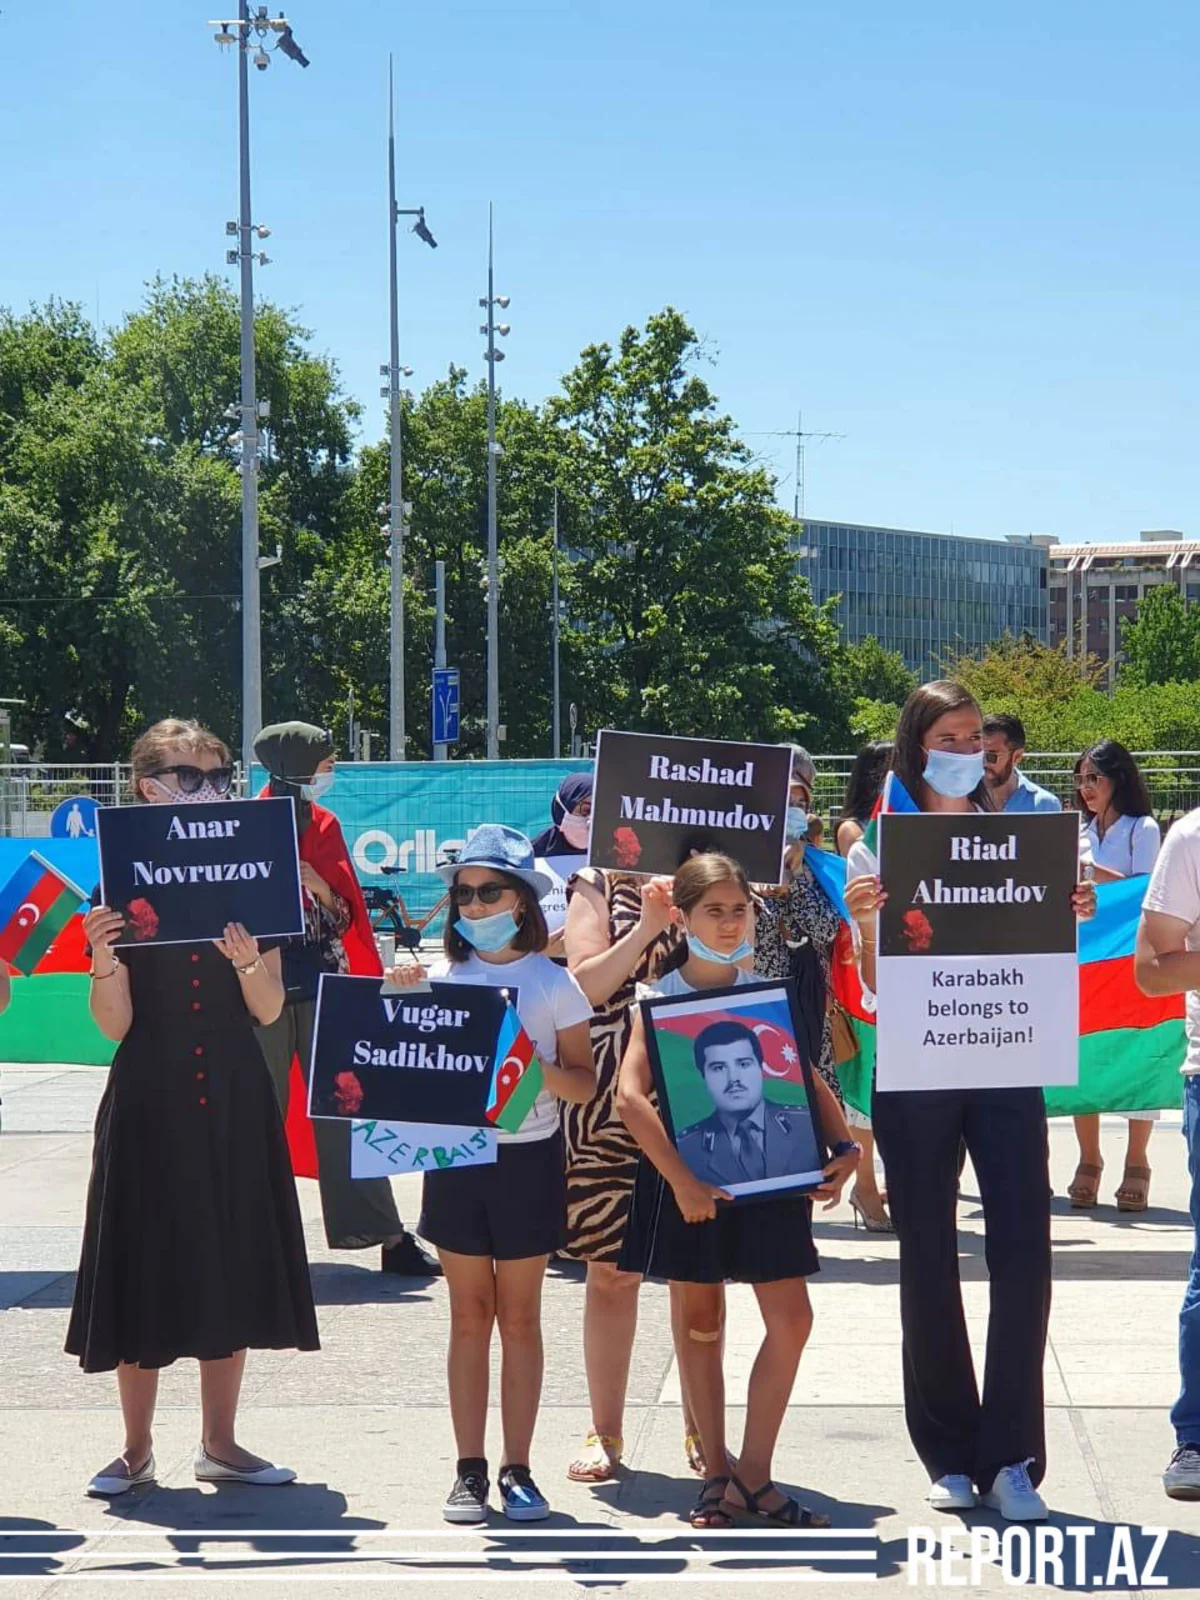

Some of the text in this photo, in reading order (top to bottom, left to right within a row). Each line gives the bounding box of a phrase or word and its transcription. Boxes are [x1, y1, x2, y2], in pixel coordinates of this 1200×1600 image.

[648, 754, 754, 787] Rashad
[620, 795, 775, 831] Mahmudov
[166, 815, 241, 840] Anar
[949, 835, 1017, 861] Riad
[132, 860, 274, 886] Novruzov
[911, 878, 1048, 903] Ahmadov
[932, 968, 1024, 987] Karabakh
[381, 998, 470, 1032] Vugar
[928, 999, 1029, 1020] belongs to
[923, 1026, 1034, 1048] Azerbaijan!
[353, 1039, 489, 1073] Sadikhov
